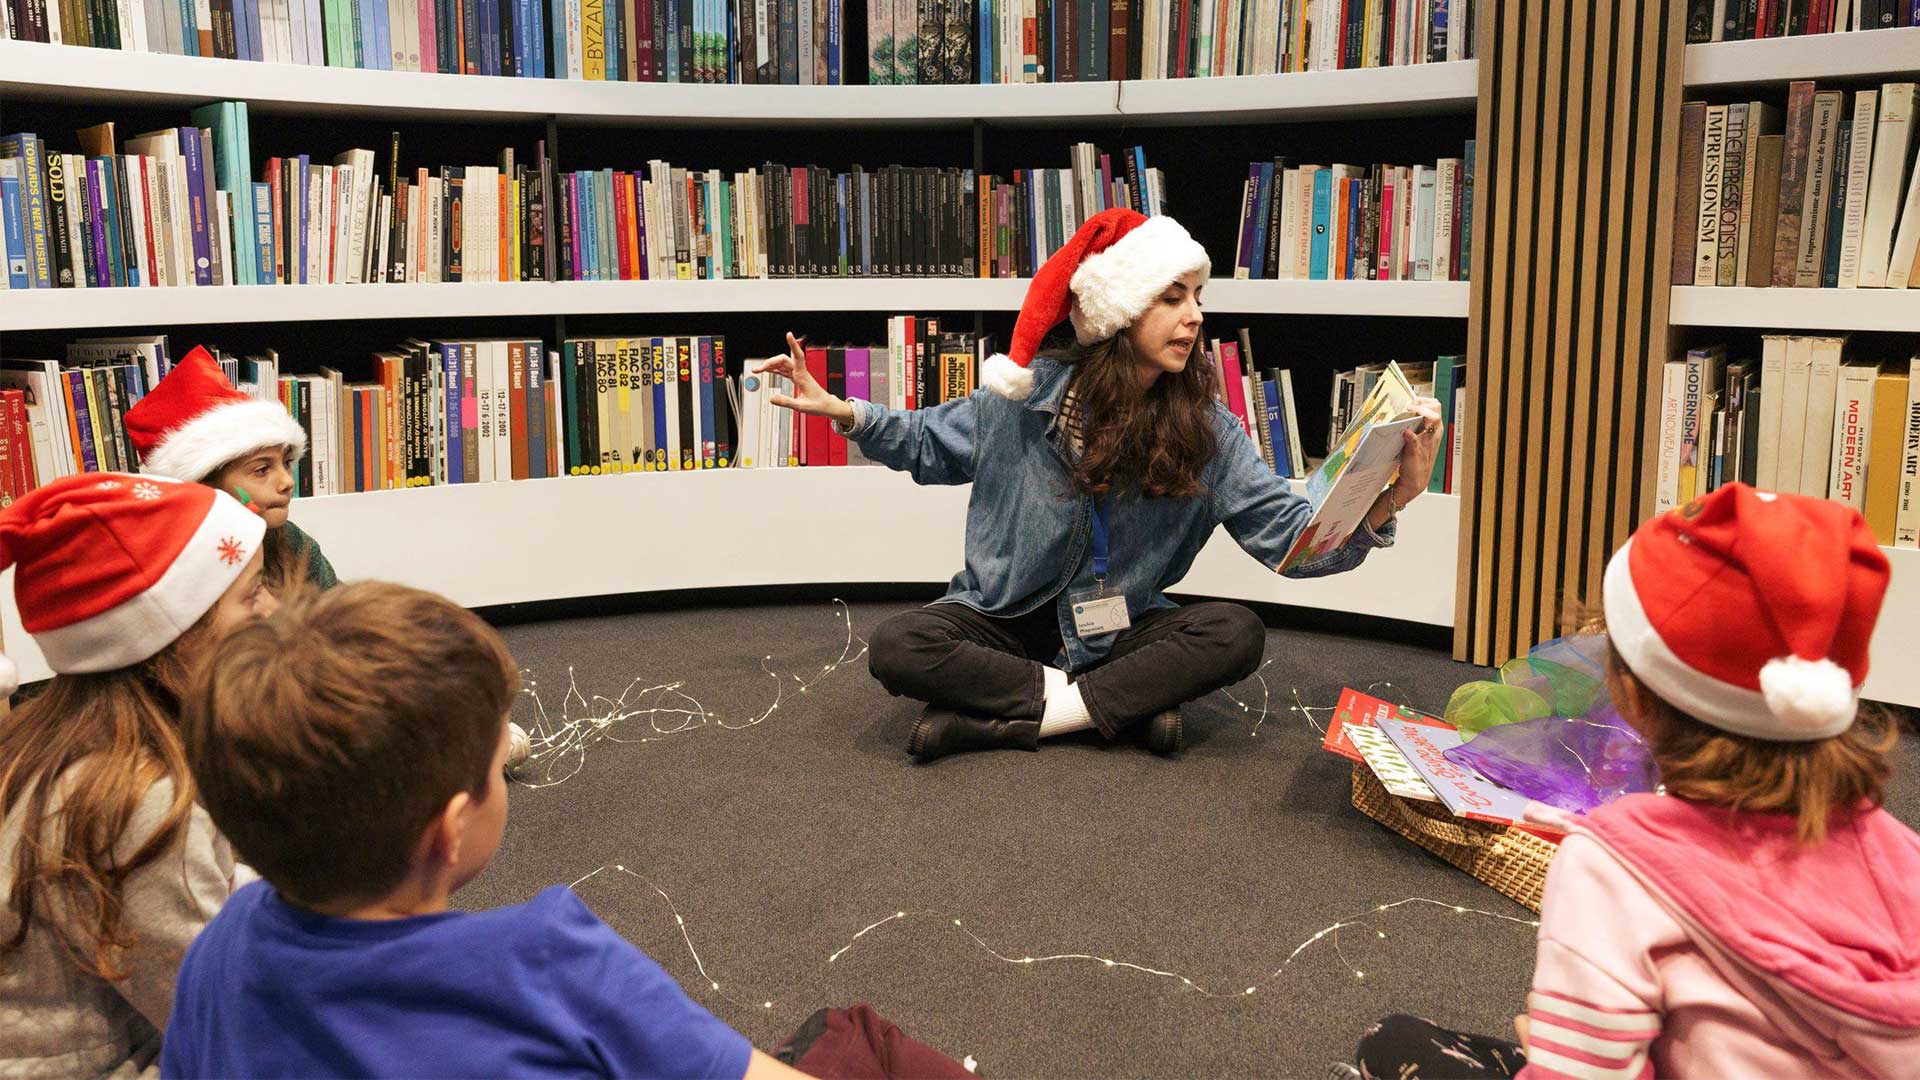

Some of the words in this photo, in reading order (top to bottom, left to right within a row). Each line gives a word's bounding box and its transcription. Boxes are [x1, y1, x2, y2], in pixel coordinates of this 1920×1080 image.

[26, 143, 40, 196] TOWARDS
[48, 155, 65, 202] SOLD
[1444, 162, 1454, 196] ROBERT
[1700, 111, 1723, 243] IMPRESSIONISM
[1814, 181, 1822, 199] dans
[1818, 146, 1826, 155] de
[20, 184, 28, 208] MUSEUM
[1273, 174, 1281, 198] CRITICAL
[1272, 198, 1280, 220] STUDIES
[1302, 200, 1310, 226] POWER
[1720, 152, 1744, 259] IMPRESSIONISTS
[21, 209, 31, 249] GOVERNANCE
[32, 208, 44, 232] NEW
[56, 206, 66, 236] NICHOLAS
[1442, 200, 1452, 238] HUGHES
[1270, 226, 1278, 250] MODERN
[1302, 227, 1308, 237] OF
[35, 234, 48, 280] MUSEUM
[928, 320, 937, 336] LIFE
[618, 349, 628, 372] FIAC
[630, 348, 639, 374] FIAC
[641, 346, 650, 372] FIAC
[653, 346, 662, 370] FIAC
[666, 346, 674, 370] FIAC
[700, 342, 710, 368] FIAC
[714, 340, 723, 365] FIAC
[916, 342, 924, 356] LIFE
[597, 354, 606, 378] FIAC
[608, 354, 616, 377] FIAC
[654, 371, 663, 384] 86
[666, 371, 675, 383] 88
[715, 366, 724, 378] 91
[598, 378, 607, 394] 80
[608, 378, 617, 388] 81
[620, 372, 628, 386] 82
[630, 374, 640, 390] 84
[642, 372, 651, 386] 85
[917, 381, 925, 393] 50
[1269, 412, 1278, 421] 01
[1666, 398, 1677, 414] ART
[1664, 414, 1676, 458] NOUVEAU
[1844, 400, 1858, 468] MODERN
[1906, 400, 1920, 451] MODERN
[1856, 427, 1864, 463] HISTORY
[1856, 466, 1861, 476] OF
[1906, 452, 1918, 477] ART
[1841, 471, 1852, 500] ART
